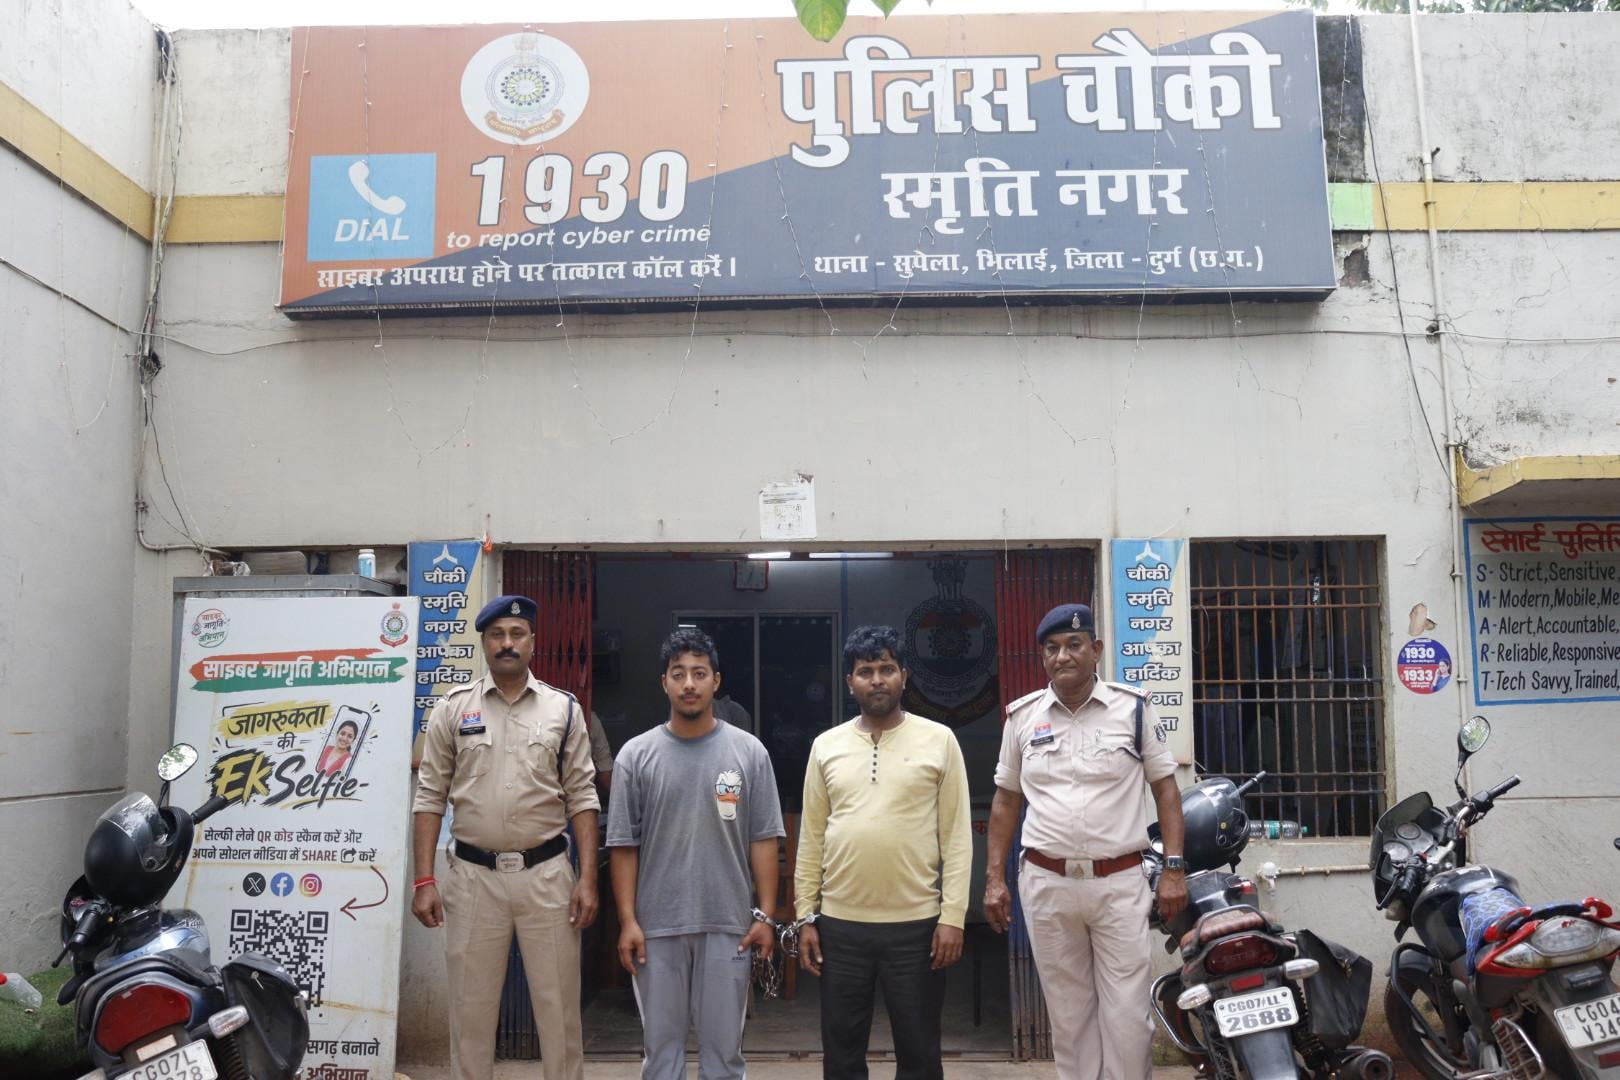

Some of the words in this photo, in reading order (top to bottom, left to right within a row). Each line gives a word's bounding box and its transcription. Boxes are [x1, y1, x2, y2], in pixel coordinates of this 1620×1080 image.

[775, 36, 1040, 167] पुलिस
[1055, 28, 1282, 133] चौकी
[472, 150, 689, 226] 1930
[881, 157, 1040, 234] स्मृति
[1055, 168, 1189, 216] नगर
[447, 231, 471, 248] to
[479, 228, 555, 250] report
[562, 226, 634, 249] cyber
[641, 224, 711, 243] crime
[814, 255, 868, 274] थाना
[1064, 247, 1124, 269] जिला
[1149, 246, 1182, 275] दुर्ग
[317, 268, 385, 288] साइबर
[390, 266, 466, 285] अपराध
[471, 261, 513, 287] होने
[518, 263, 544, 282] पर
[552, 261, 627, 281] तत्काल
[632, 255, 684, 279] कॉल
[690, 254, 723, 278] करें
[424, 566, 466, 584] चौकी
[1126, 563, 1171, 581] चौकी
[422, 591, 467, 613] स्मृति
[1127, 588, 1172, 611] स्मृति
[424, 620, 466, 634] नगर
[1130, 617, 1172, 631] नगर
[417, 644, 473, 659] आपका
[1122, 641, 1181, 657] आपका
[1404, 647, 1436, 659] 1930
[202, 660, 259, 679] साइबर
[261, 655, 314, 686] जागृति
[317, 655, 391, 678] अभियान
[417, 666, 471, 683] हार्दिक
[1124, 662, 1180, 682] हार्दिक
[1403, 670, 1434, 681] 1933
[277, 731, 297, 750] की
[215, 752, 273, 806] Ek
[204, 827, 233, 842] सेल्फी
[236, 828, 255, 842] लेने
[257, 831, 271, 844] QR
[274, 828, 294, 842] कोड
[296, 828, 321, 843] स्कैन
[324, 828, 343, 844] करें
[343, 828, 363, 844] और
[192, 846, 216, 860] अपने
[219, 845, 251, 861] सोशल
[253, 846, 287, 861] मीडिया
[289, 847, 302, 862] में
[302, 850, 337, 862] SHARE
[358, 848, 377, 863] करें
[1574, 997, 1620, 1023] CG04
[1226, 1007, 1292, 1033] 2688
[341, 1037, 381, 1056] बनाने
